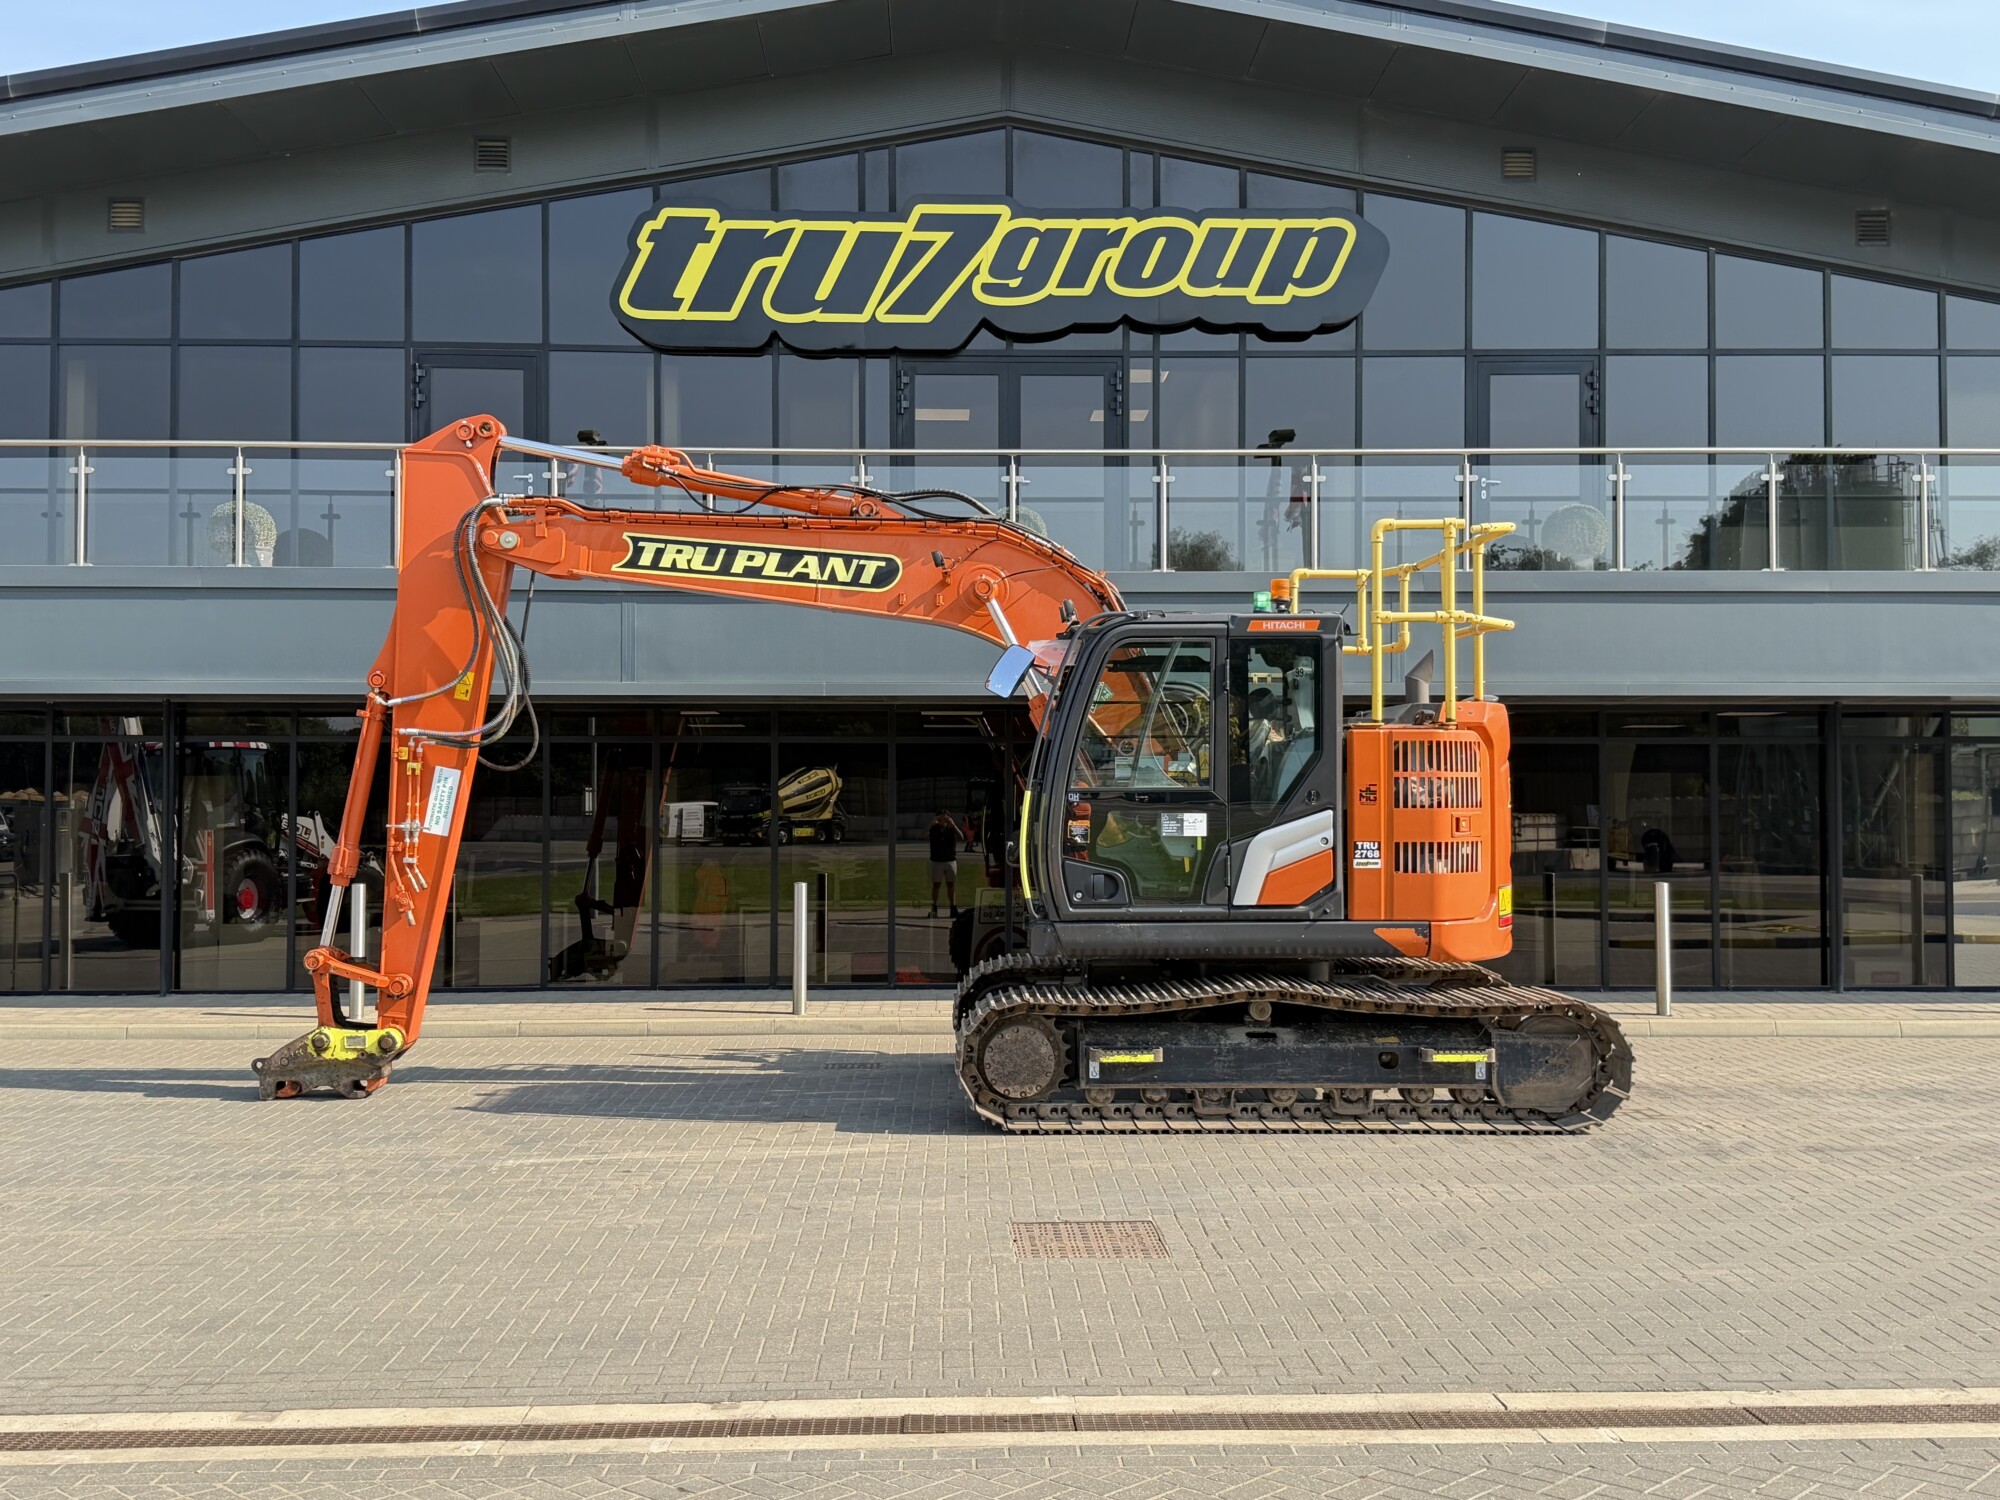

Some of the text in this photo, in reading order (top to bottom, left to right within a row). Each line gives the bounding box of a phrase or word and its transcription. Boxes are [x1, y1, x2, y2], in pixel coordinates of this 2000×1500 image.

[637, 541, 886, 585] TRU PLANT
[1262, 621, 1305, 629] HITACHI
[437, 790, 445, 814] SAFETY
[443, 785, 453, 818] REQUIRED
[1354, 850, 1380, 858] 2768
